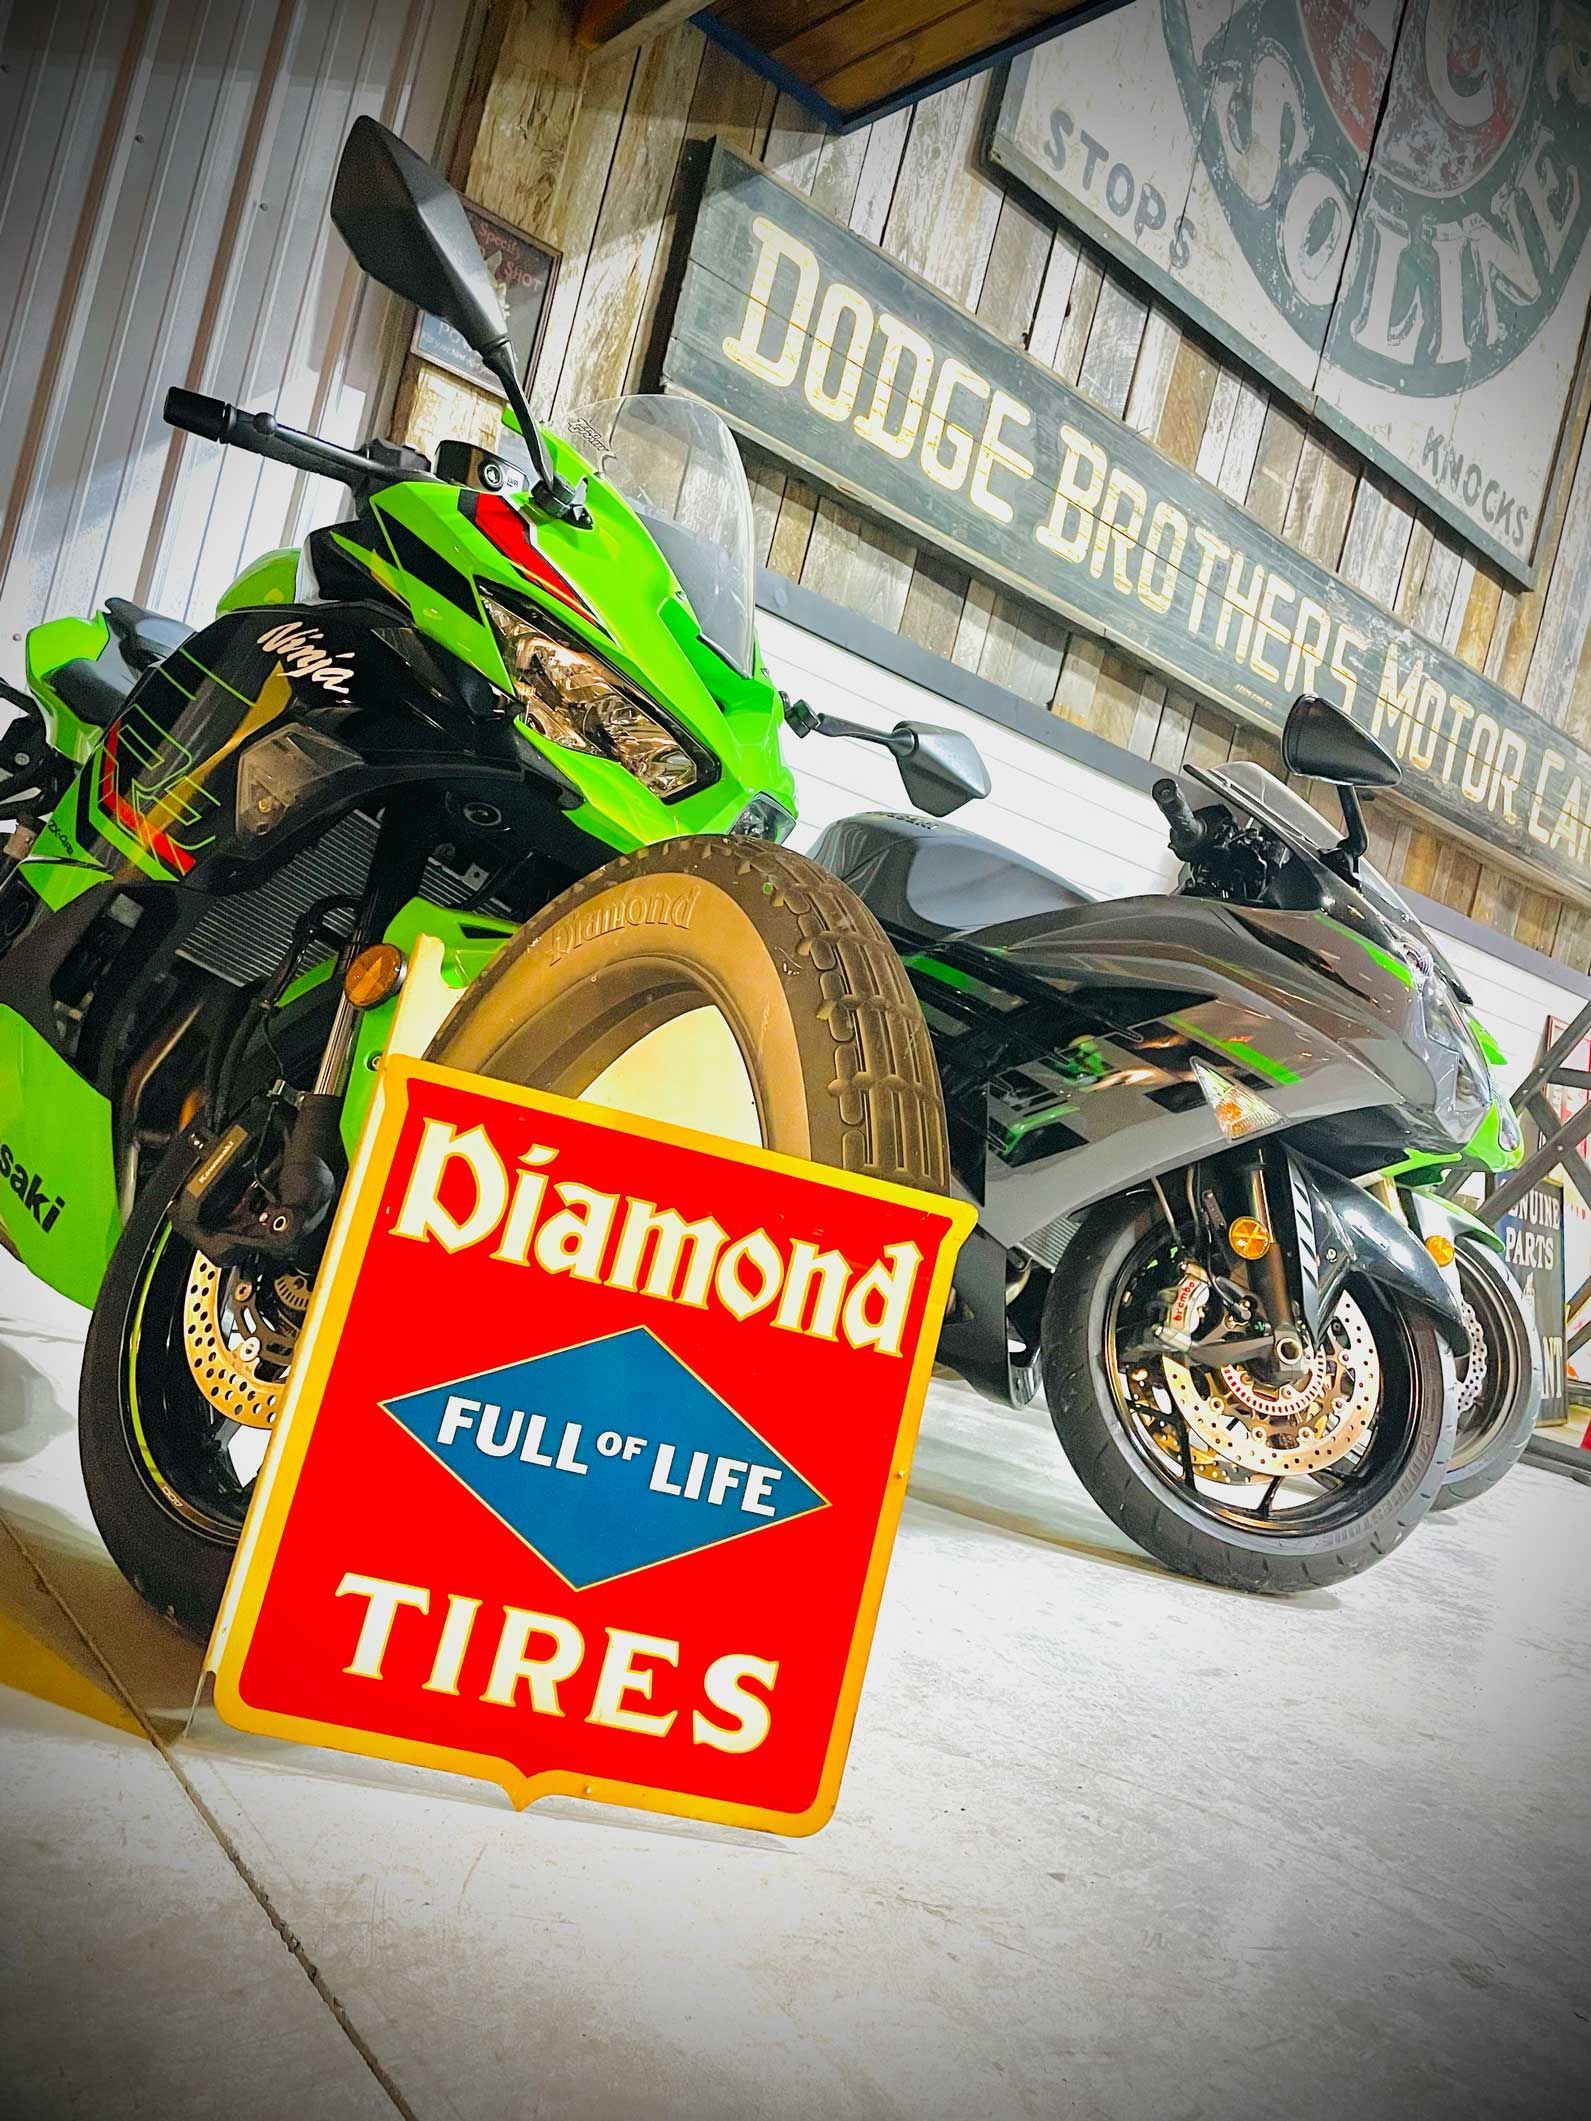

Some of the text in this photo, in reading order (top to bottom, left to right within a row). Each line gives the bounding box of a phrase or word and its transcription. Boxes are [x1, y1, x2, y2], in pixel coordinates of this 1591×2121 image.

[1044, 109, 1199, 269] STOPS
[1188, 0, 1580, 365] SOLINE
[722, 216, 1035, 524] DODGE
[1036, 424, 1369, 714] BROTHERS
[1369, 642, 1527, 826] MOTOR
[1423, 426, 1530, 546] KNOCKS
[257, 621, 355, 694] Ninja
[546, 884, 700, 967] Diamond
[388, 1116, 924, 1359] Diamond
[1500, 1178, 1560, 1231] NUINE
[1505, 1226, 1554, 1271] PARTS
[436, 1395, 782, 1518] FULL OF LIFE
[334, 1571, 780, 1754] TIRES
